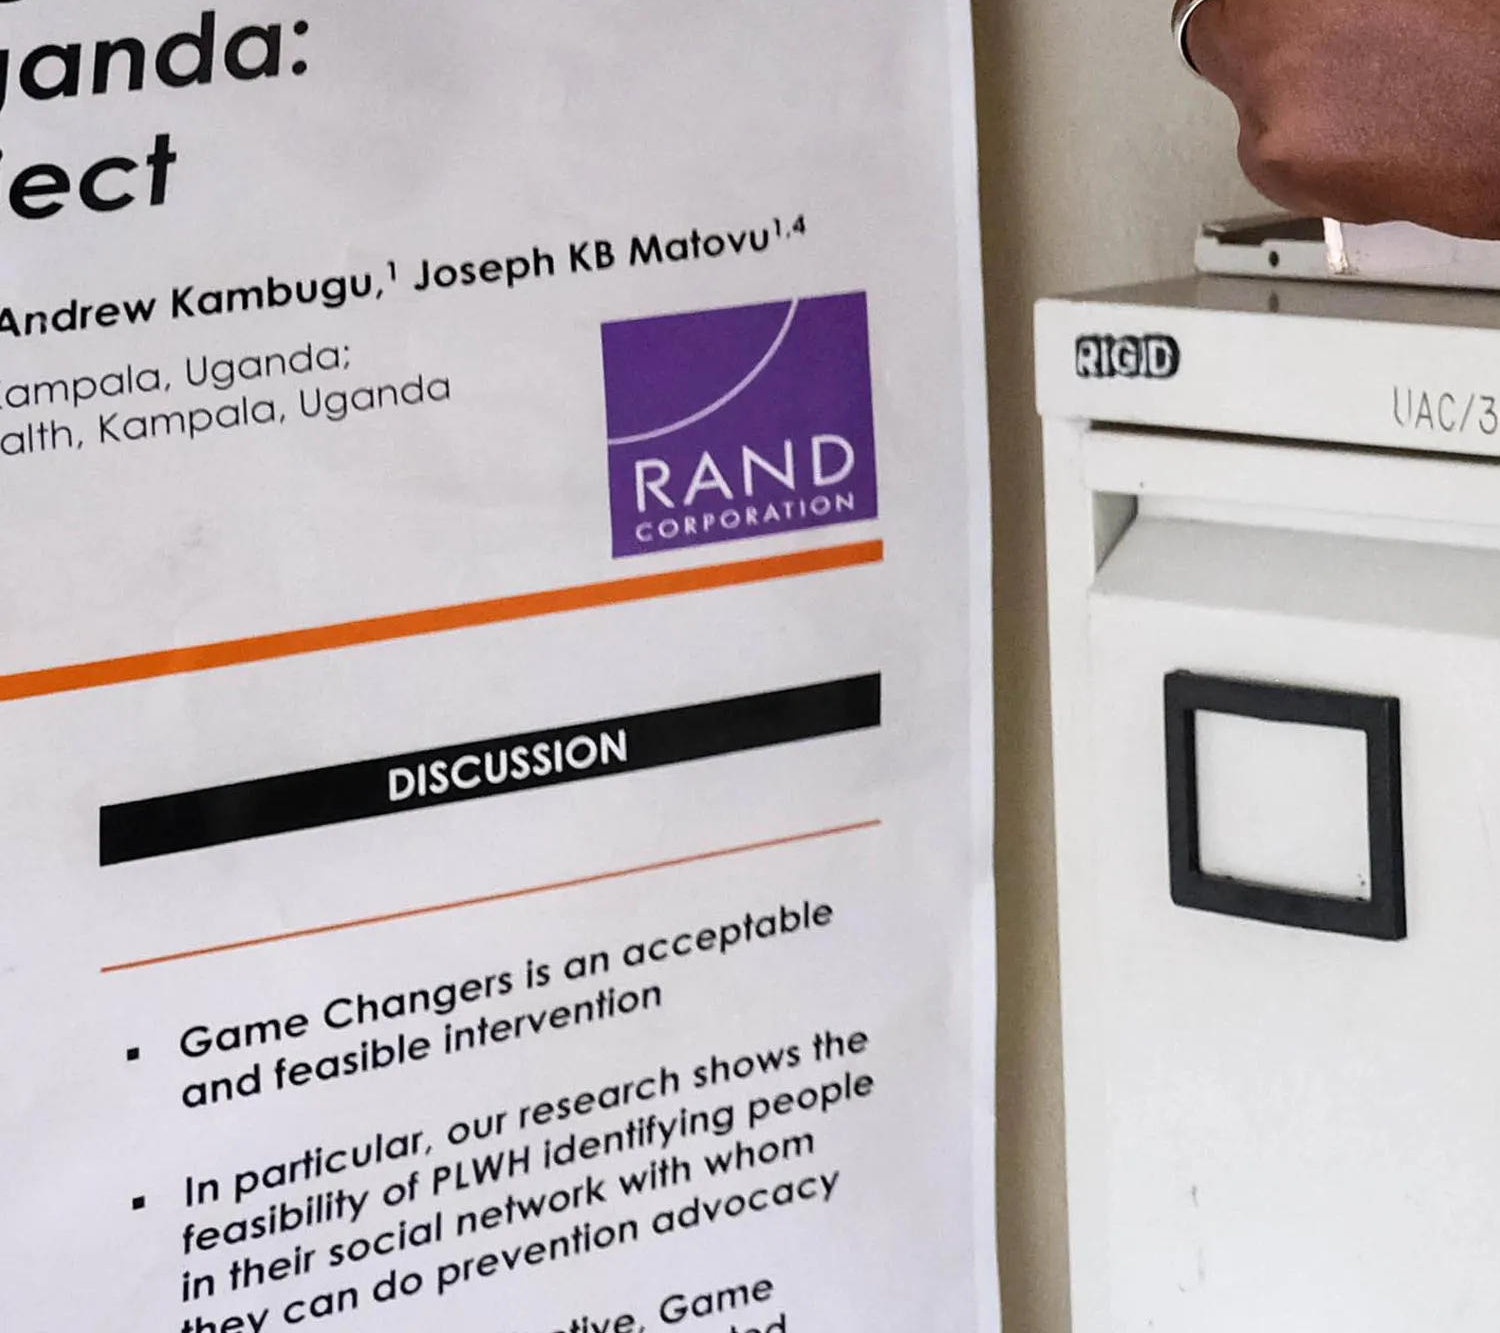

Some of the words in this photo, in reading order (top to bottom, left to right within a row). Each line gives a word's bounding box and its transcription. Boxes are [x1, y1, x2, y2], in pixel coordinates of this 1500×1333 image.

[0, 133, 177, 220] ect
[0, 297, 156, 337] Andrew
[413, 247, 555, 290] Joseph
[569, 240, 615, 274] KB
[0, 364, 171, 409] ampala,
[186, 343, 350, 390] Uganda;
[99, 396, 286, 444] Kampala,
[300, 375, 450, 422] Uganda
[634, 433, 856, 513] RAND
[635, 492, 855, 543] CORPORATION
[388, 729, 628, 803] DISCUSSION
[180, 1013, 309, 1058] Game
[324, 971, 512, 1029] Changers
[526, 959, 550, 989] is
[564, 951, 609, 979] an
[622, 901, 834, 967] acceptable
[182, 1063, 262, 1108] and
[274, 1034, 431, 1090] feasible
[445, 984, 662, 1054] intervention
[182, 1189, 369, 1254] feasibility
[383, 1171, 418, 1206] of
[433, 1146, 530, 1195] PLWH
[544, 1104, 734, 1169] identifying
[747, 1070, 875, 1128] people
[185, 1176, 219, 1207] In
[235, 1131, 432, 1203] particular,
[447, 1111, 506, 1144] our
[519, 1066, 680, 1129] research
[693, 1045, 801, 1088] shows
[813, 1030, 869, 1061] the
[182, 1271, 215, 1302] in
[230, 1246, 315, 1291] their
[329, 1212, 441, 1267] social
[457, 1176, 606, 1236] network
[619, 1157, 690, 1195] with
[705, 1132, 814, 1175] whom
[283, 1286, 358, 1324] can
[373, 1270, 423, 1303] do
[437, 1219, 638, 1295] prevention
[652, 1170, 840, 1236] advocacy
[659, 1278, 773, 1325] Game
